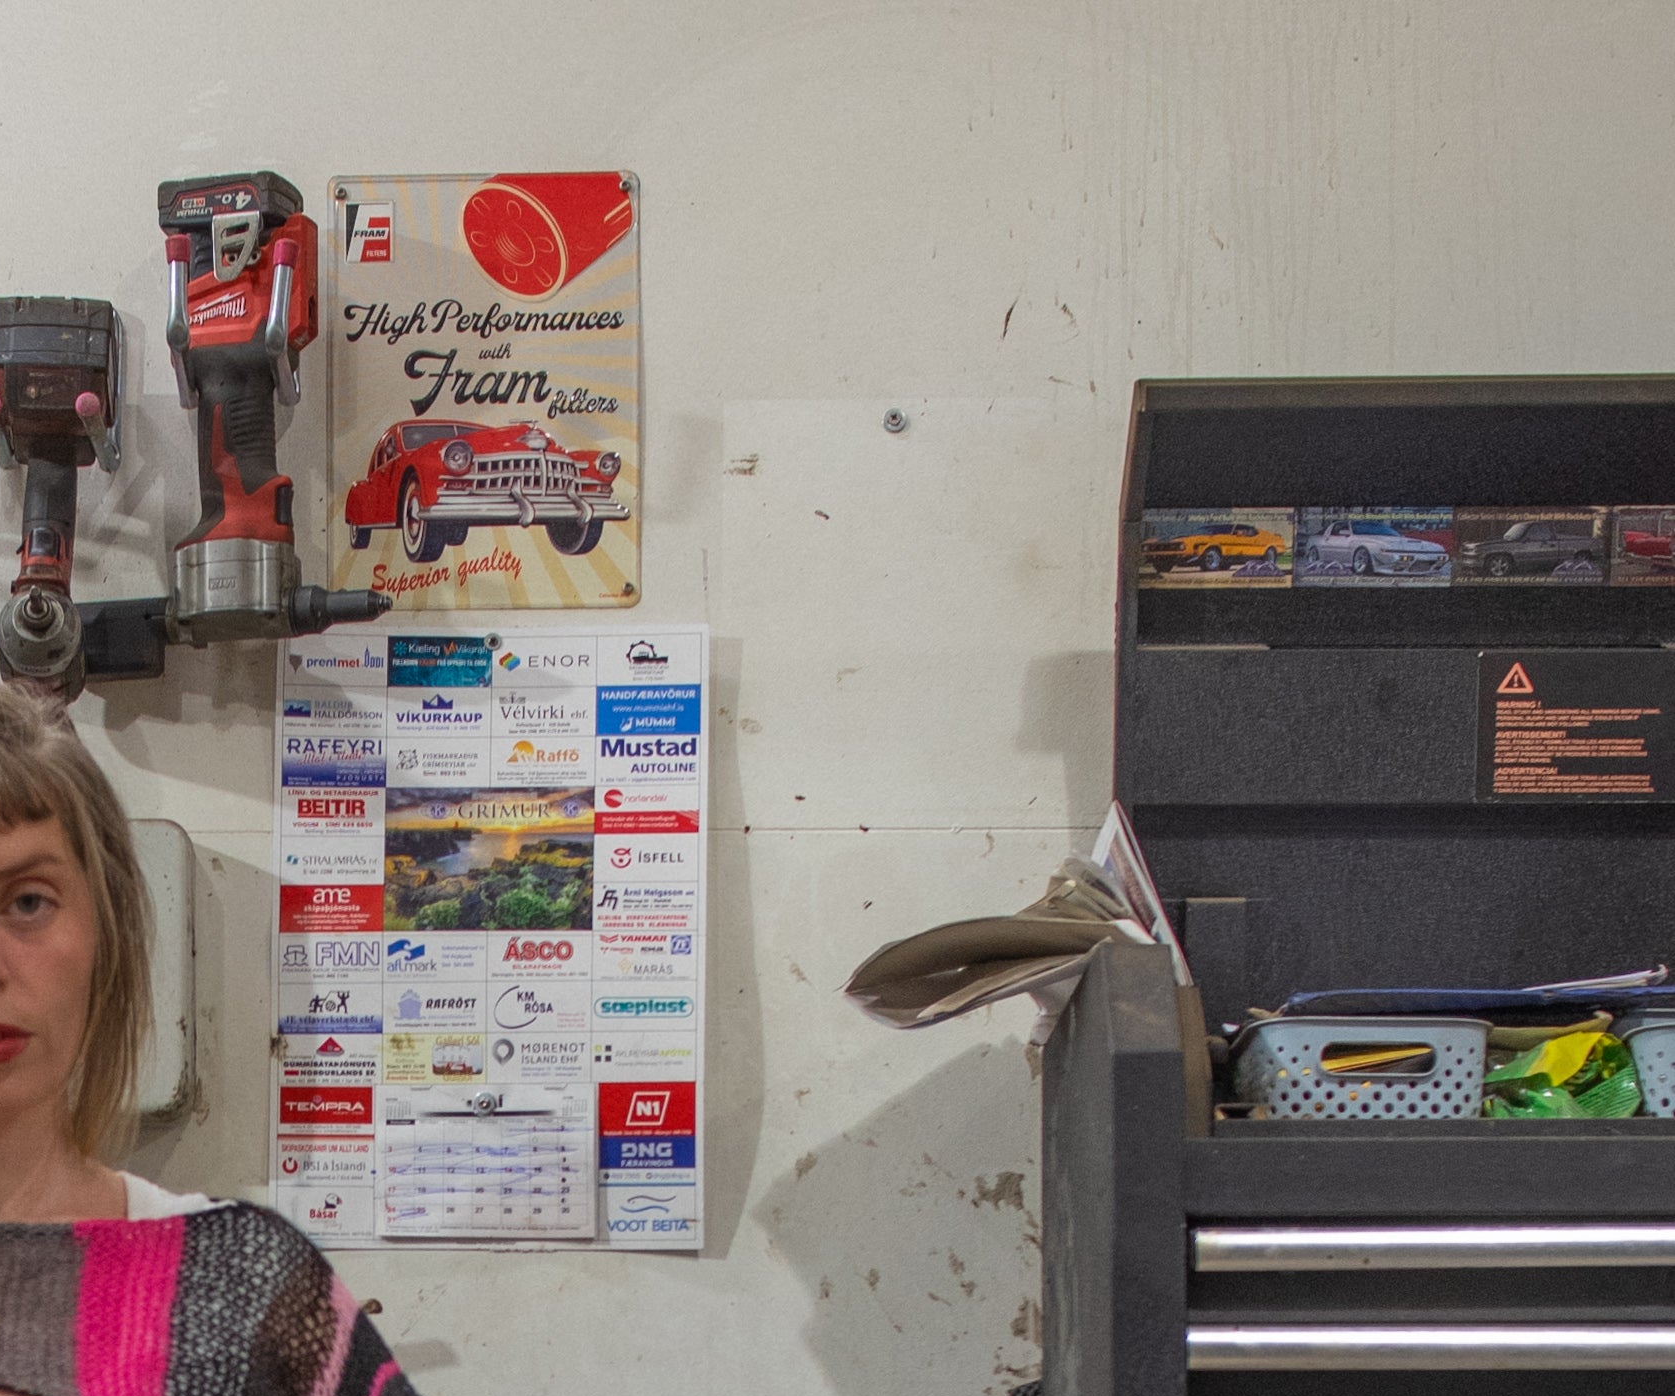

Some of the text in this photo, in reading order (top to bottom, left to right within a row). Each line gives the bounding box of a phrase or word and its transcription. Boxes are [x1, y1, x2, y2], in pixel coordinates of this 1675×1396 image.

[354, 229, 386, 238] FRAM
[344, 299, 625, 345] High Performances
[478, 343, 511, 360] with
[404, 348, 551, 417] Fram
[547, 388, 619, 419] filters
[371, 546, 523, 599] Superior quality
[306, 658, 360, 669] prentmet
[528, 654, 590, 668] ENOR
[396, 710, 483, 723] VÍKURKAUP
[500, 704, 564, 720] Vélvirki
[635, 717, 676, 728] MUMMI
[287, 738, 383, 756] RAFEYRI
[600, 737, 697, 757] Mustad
[631, 762, 697, 773] AUTOLINE
[297, 798, 366, 816] BEITIR
[458, 801, 551, 820] GRÍMUR
[638, 850, 684, 863] ÍSFELL
[312, 887, 352, 904] ame
[621, 935, 668, 943] YANMAR
[315, 940, 380, 967] FMN
[516, 991, 535, 1001] KM
[521, 1041, 586, 1054] MØRENOT
[285, 1101, 365, 1112] TEMPRA
[635, 1101, 661, 1116] N1
[309, 1207, 338, 1219] Básar
[607, 1218, 690, 1232] VOOT BEITA
